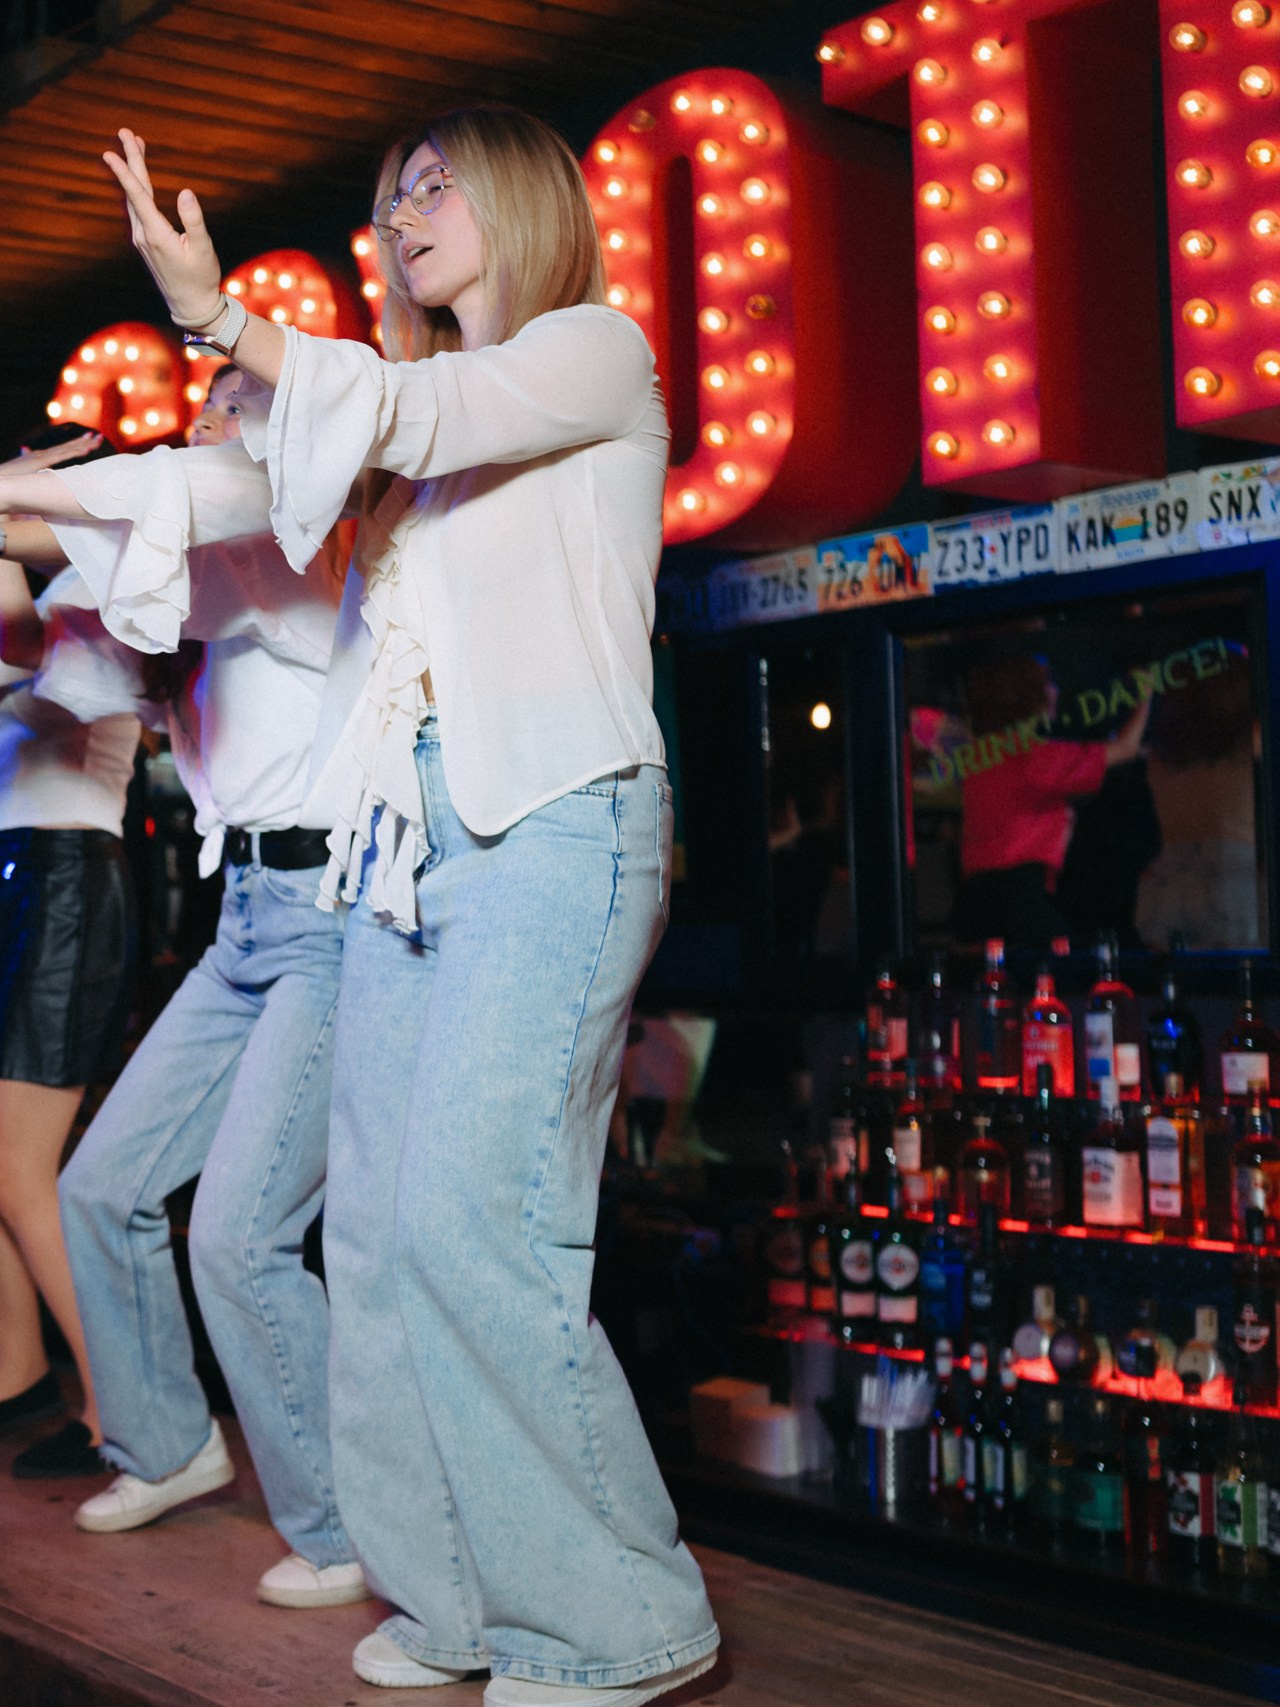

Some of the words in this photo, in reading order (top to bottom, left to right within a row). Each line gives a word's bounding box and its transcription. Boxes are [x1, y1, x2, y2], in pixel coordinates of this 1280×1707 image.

[1066, 511, 1117, 555] KAK
[1140, 498, 1189, 542] 189
[1208, 484, 1261, 525] SNX
[936, 533, 986, 578] Z33
[999, 522, 1050, 566] YPD
[929, 711, 1051, 789] DRINK!
[1077, 635, 1228, 727] DANCE!
